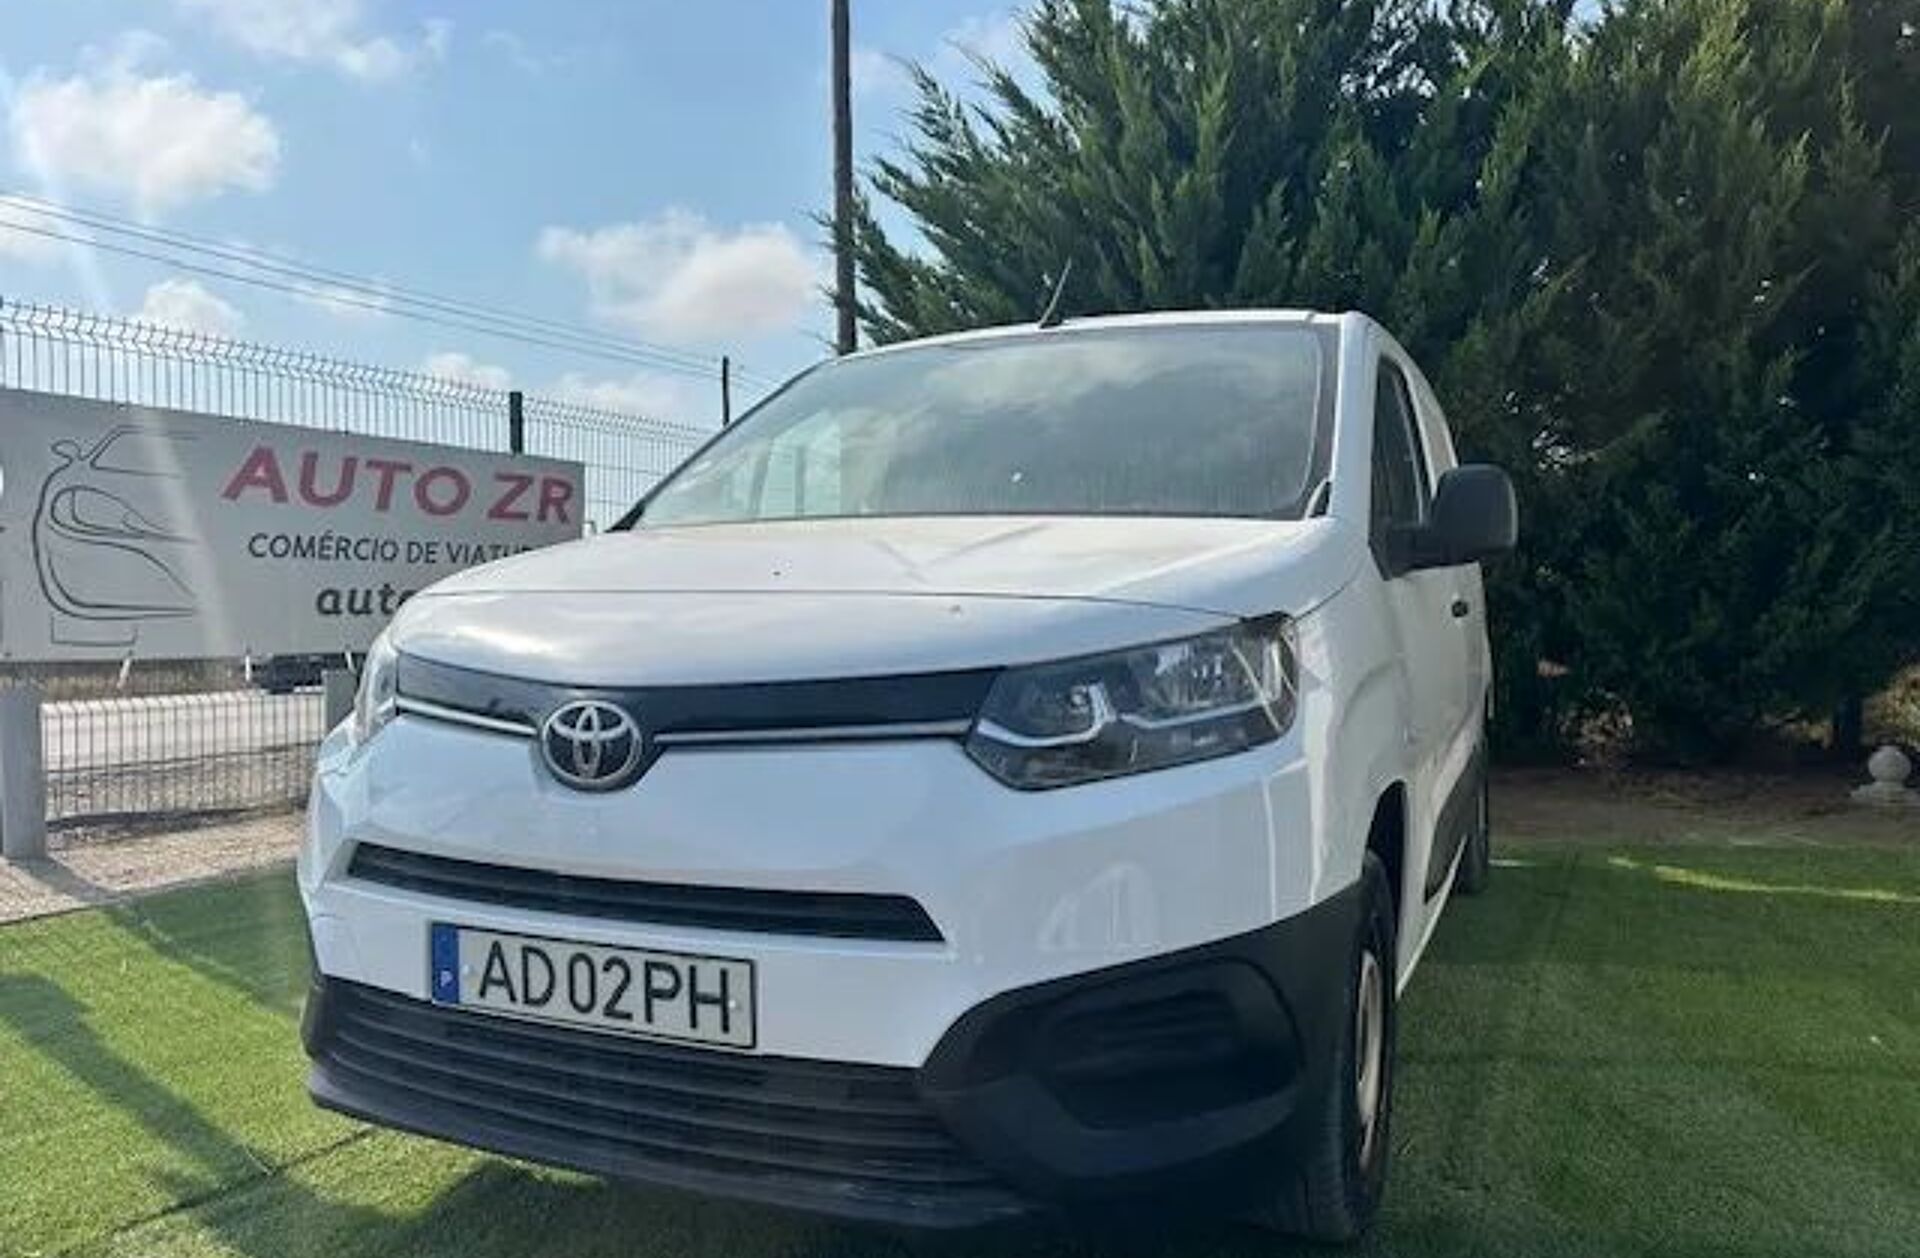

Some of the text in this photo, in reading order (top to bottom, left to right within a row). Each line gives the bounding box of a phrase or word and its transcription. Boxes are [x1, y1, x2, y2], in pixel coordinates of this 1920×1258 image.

[221, 444, 574, 523] AUTO ZR
[248, 530, 400, 562] COMÉRCIO
[406, 541, 439, 564] DE
